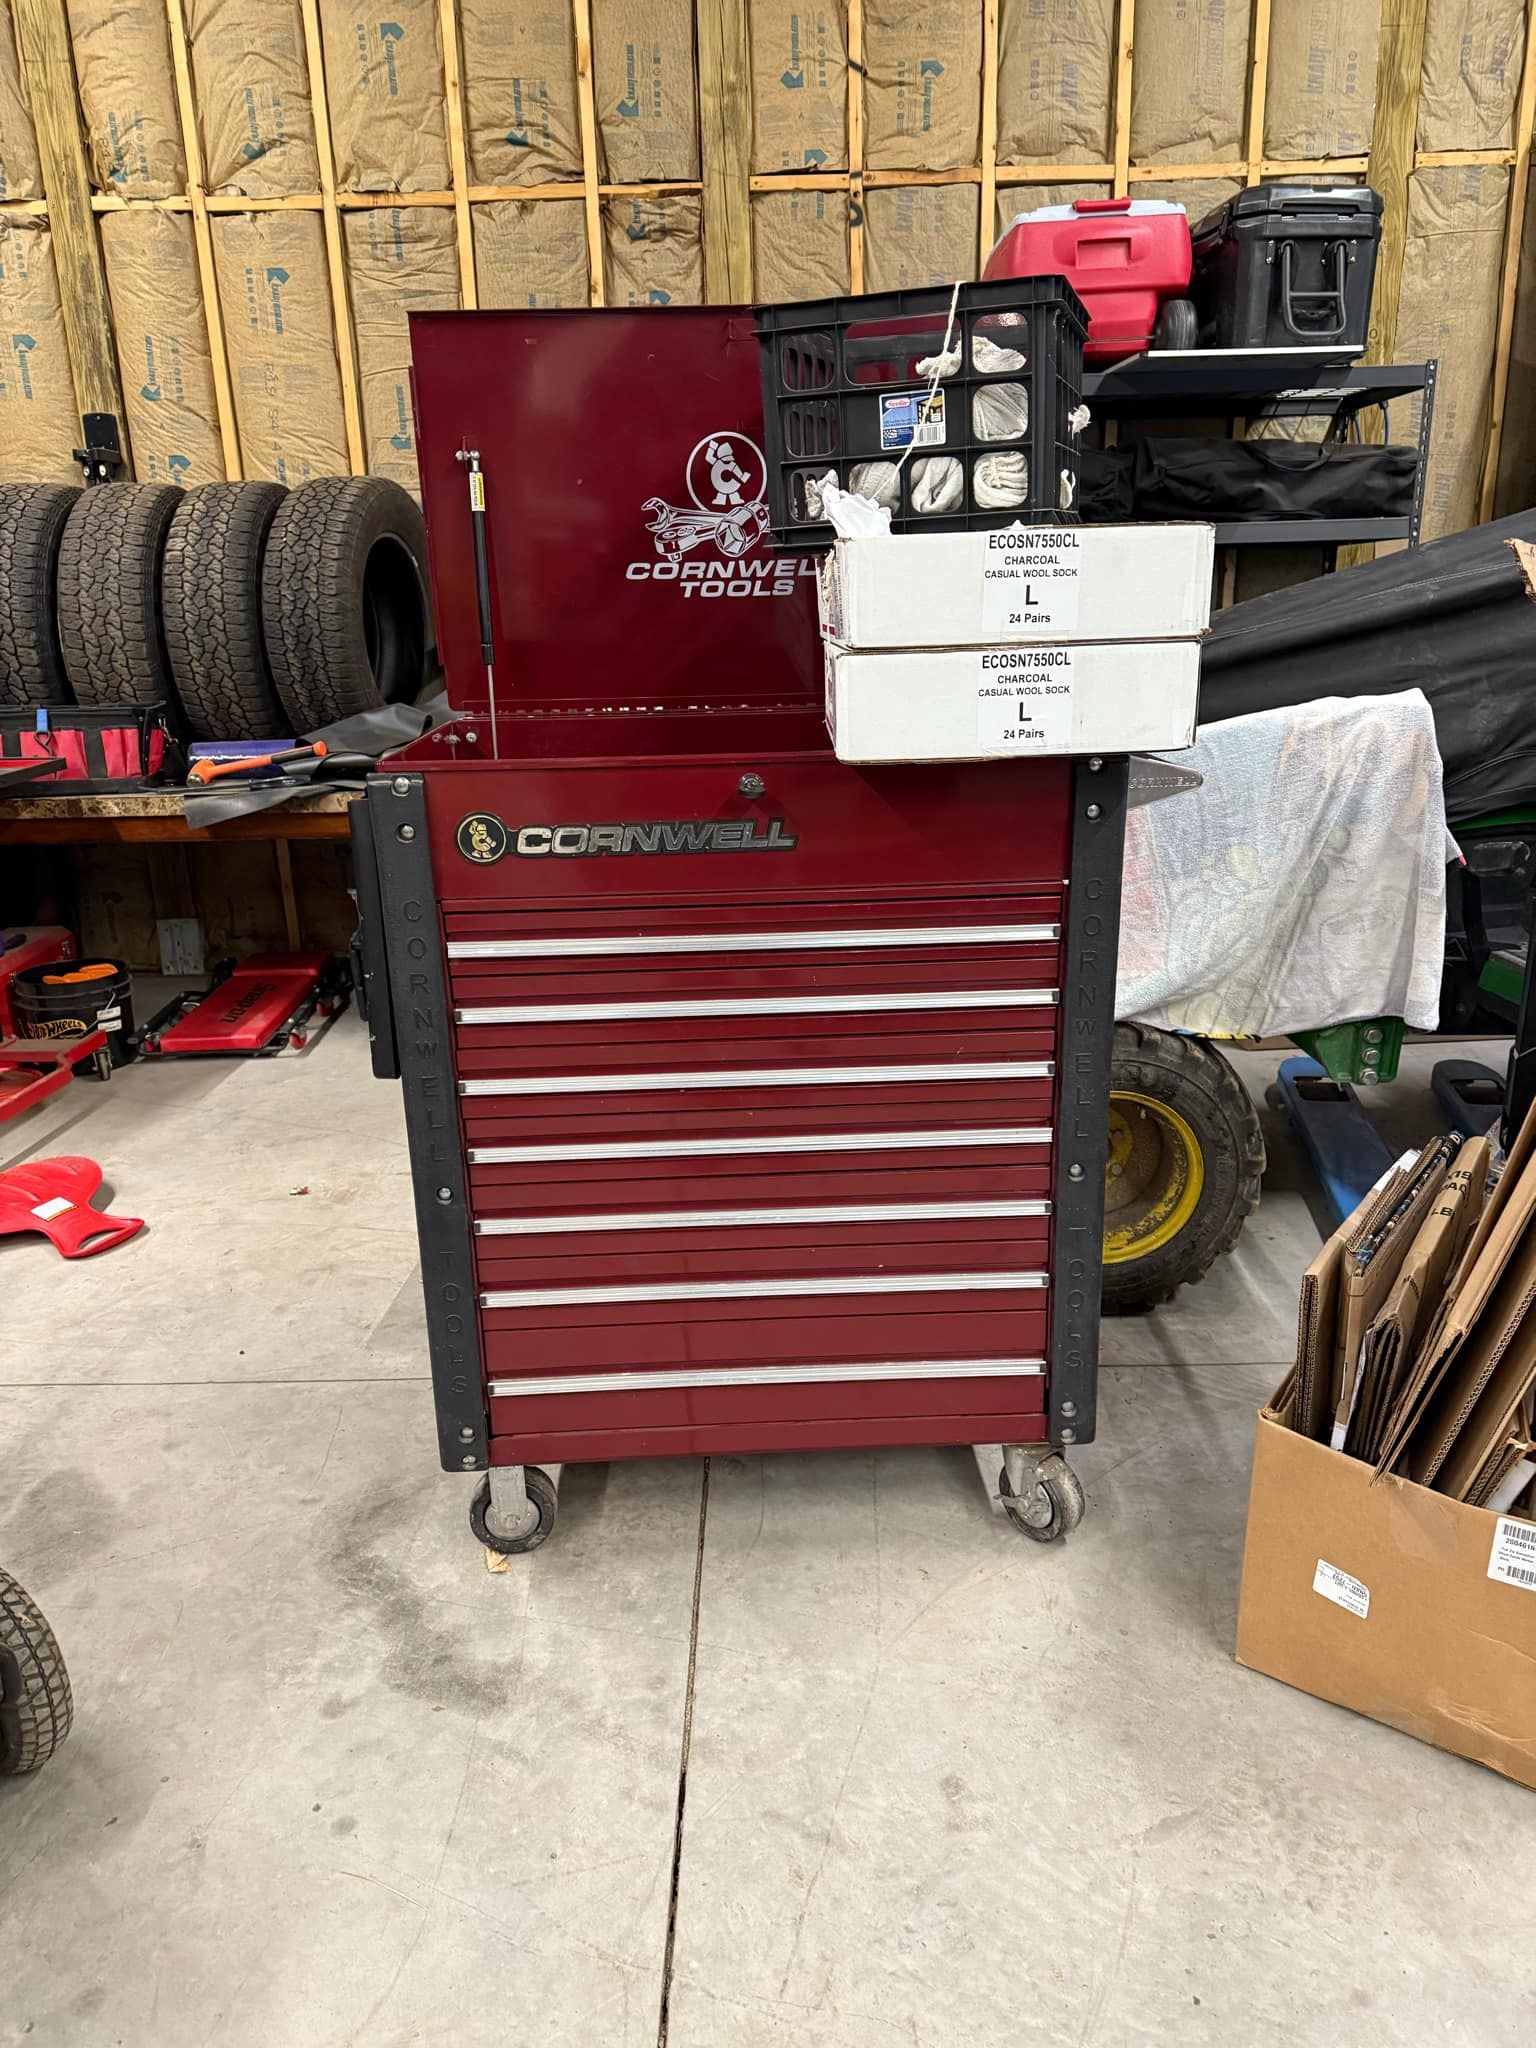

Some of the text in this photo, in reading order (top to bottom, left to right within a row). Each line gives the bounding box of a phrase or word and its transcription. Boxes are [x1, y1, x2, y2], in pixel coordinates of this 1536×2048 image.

[988, 533, 1080, 549] ECOSN7550CL
[625, 558, 818, 581] CORNWEL
[1004, 555, 1061, 566] CHARCOAL
[984, 568, 1079, 579] CASUAL WOOL SOCK
[679, 579, 795, 599] TOOLS
[1025, 584, 1039, 606] L
[1008, 613, 1051, 624] 24 Pairs
[981, 651, 1072, 669] ECOSN7550CL
[997, 673, 1053, 685] CHARCOAL
[978, 685, 1071, 697] CASUAL WOOL SOCK
[1018, 702, 1033, 722] L
[1003, 728, 1045, 740] 24 Pairs
[515, 820, 798, 855] CORNWELL
[1074, 877, 1104, 1137] CORNWELL
[402, 898, 449, 1162] CORNWELL
